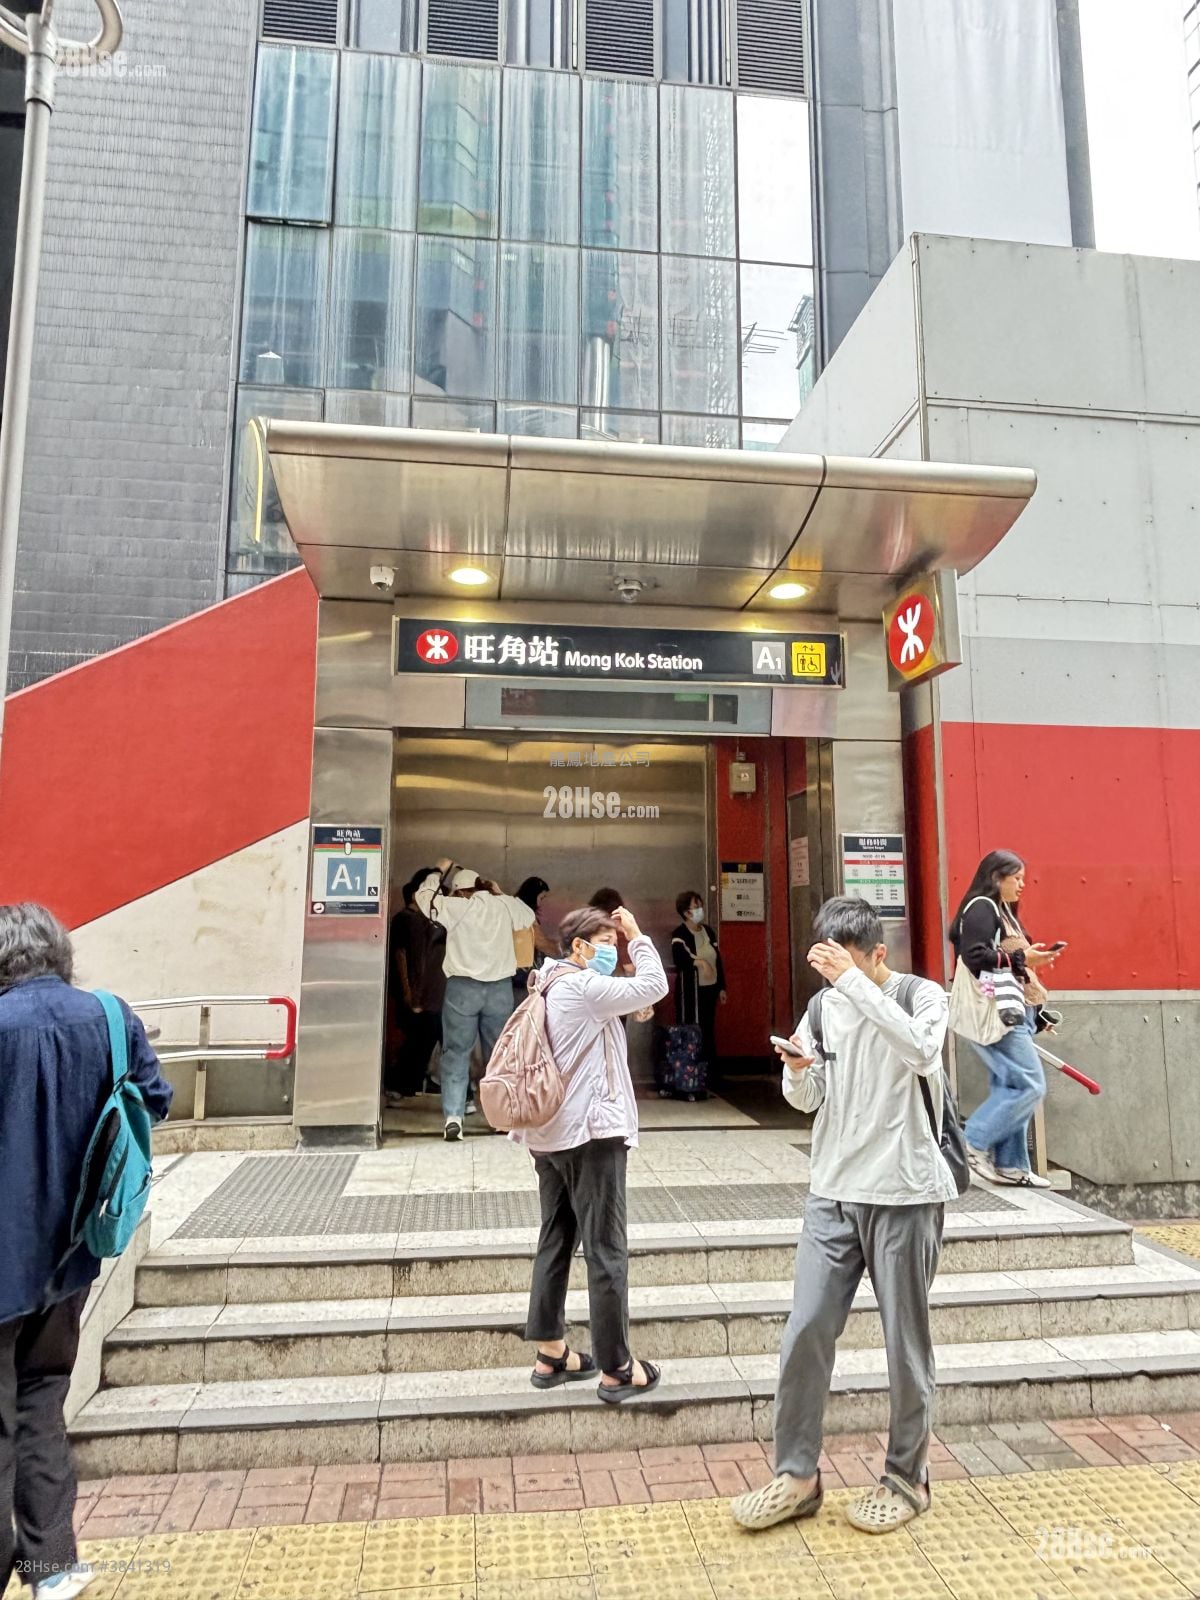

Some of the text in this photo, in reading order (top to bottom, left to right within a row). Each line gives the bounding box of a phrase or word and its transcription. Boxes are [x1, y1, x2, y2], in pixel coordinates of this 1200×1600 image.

[464, 634, 559, 667] 旺角站
[564, 651, 703, 671] Mong Kok Station
[756, 646, 782, 670] A1
[331, 863, 360, 890] A1
